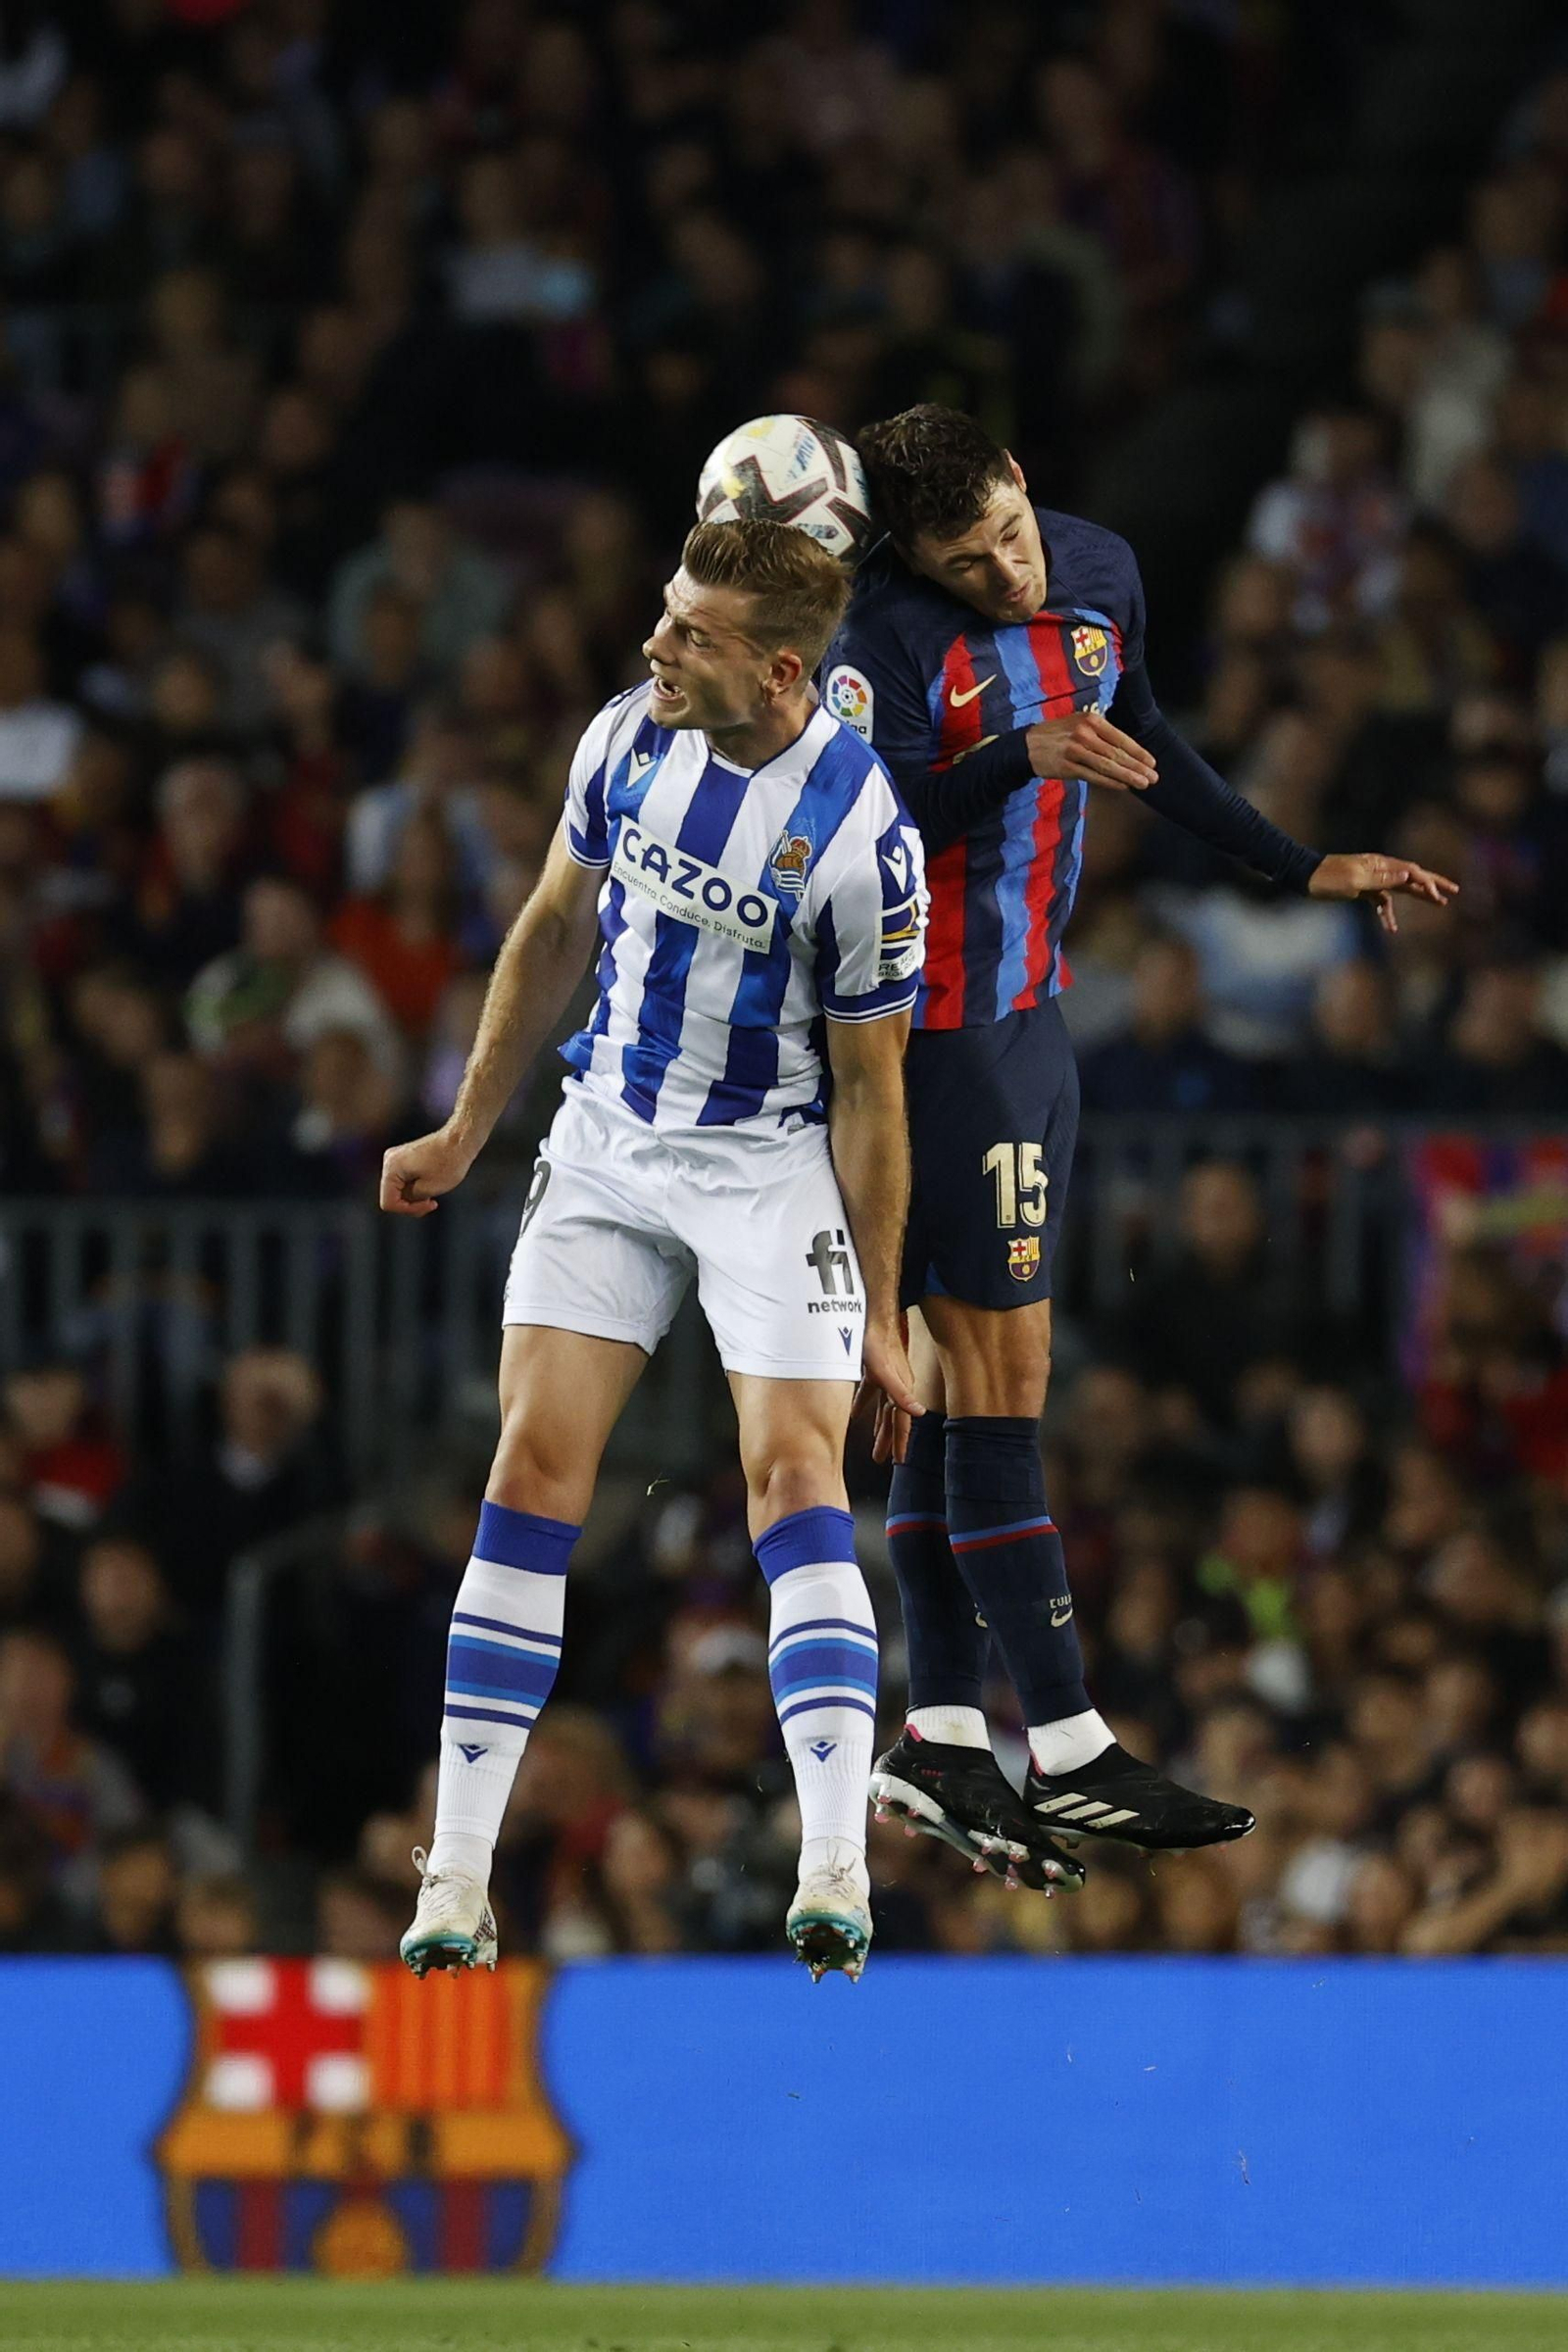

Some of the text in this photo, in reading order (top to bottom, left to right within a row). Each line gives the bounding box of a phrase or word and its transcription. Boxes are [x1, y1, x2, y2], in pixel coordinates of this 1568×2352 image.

[621, 828, 768, 928] CAZOO
[660, 894, 710, 927] Conduce.
[713, 920, 766, 949] Disfruta.
[982, 1142, 1049, 1229] 15
[806, 1228, 855, 1295] fi
[807, 1298, 862, 1314] network
